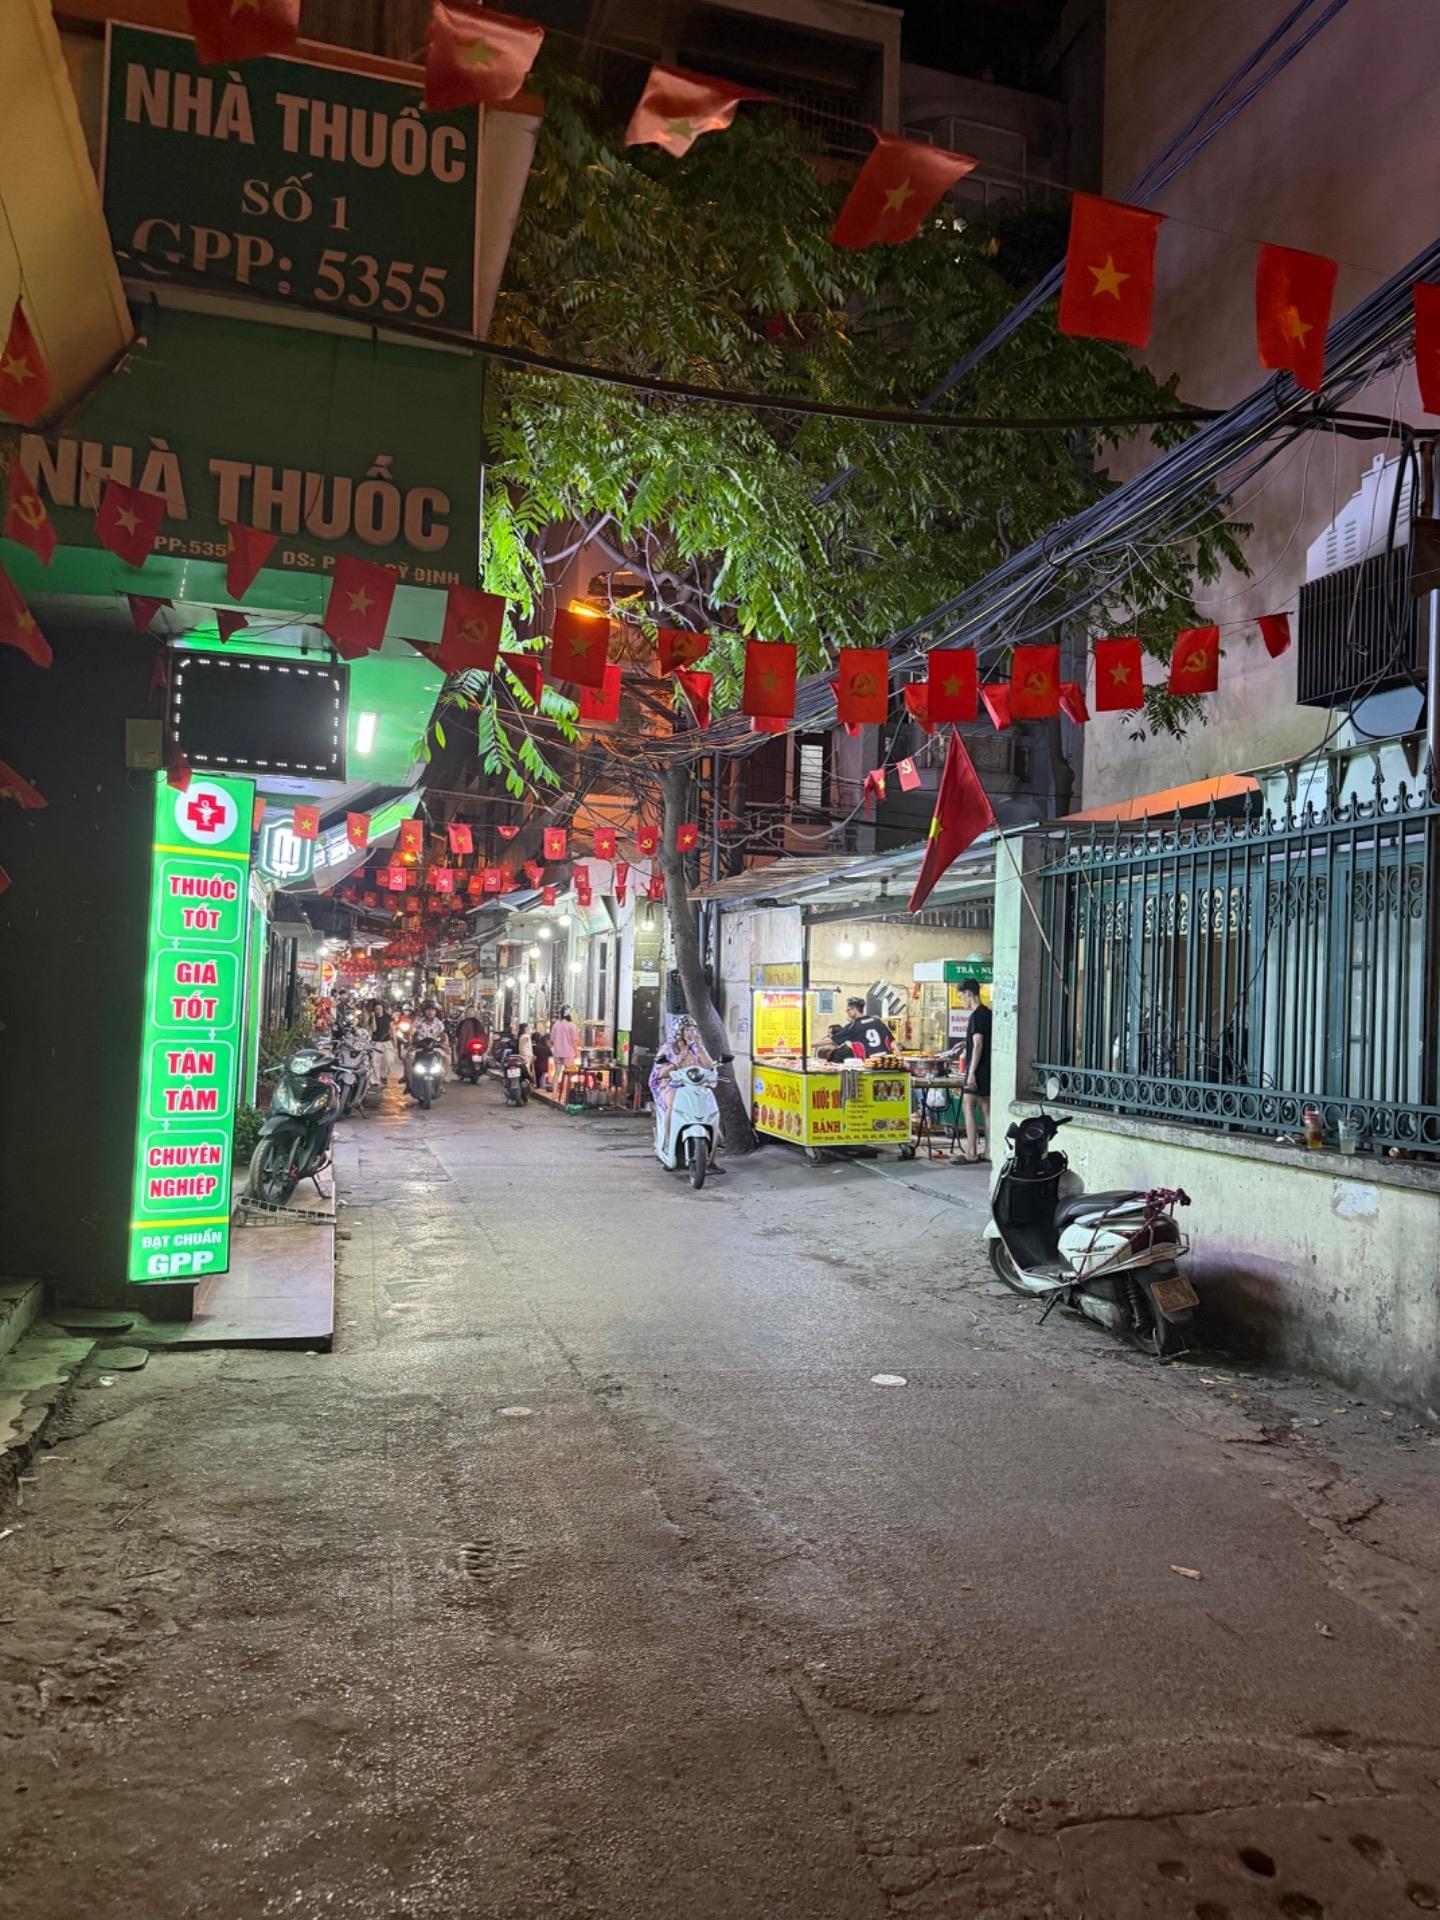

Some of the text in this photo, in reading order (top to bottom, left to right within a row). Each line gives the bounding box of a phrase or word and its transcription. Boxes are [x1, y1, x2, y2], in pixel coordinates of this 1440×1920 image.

[125, 63, 467, 183] NHÀ THUỐC
[241, 172, 350, 231] SỐ 1
[314, 249, 448, 318] 5355
[19, 432, 451, 551] NHÀ THUỐC
[153, 536, 228, 557] PP:535
[282, 551, 315, 568] DS:
[414, 568, 460, 586] ĐỊNH
[169, 873, 236, 900] THUỐC
[183, 903, 220, 929] TỐT
[175, 960, 217, 985] GIÁ
[172, 991, 217, 1019] TỐT
[866, 1029, 881, 1047] 9
[167, 1049, 214, 1078] TẬN
[165, 1087, 217, 1112] TÂM
[149, 1143, 221, 1167] CHUYÊN
[150, 1174, 217, 1199] NGHIỆP
[142, 1235, 169, 1249] ĐẠT
[147, 1250, 214, 1275] GPP
